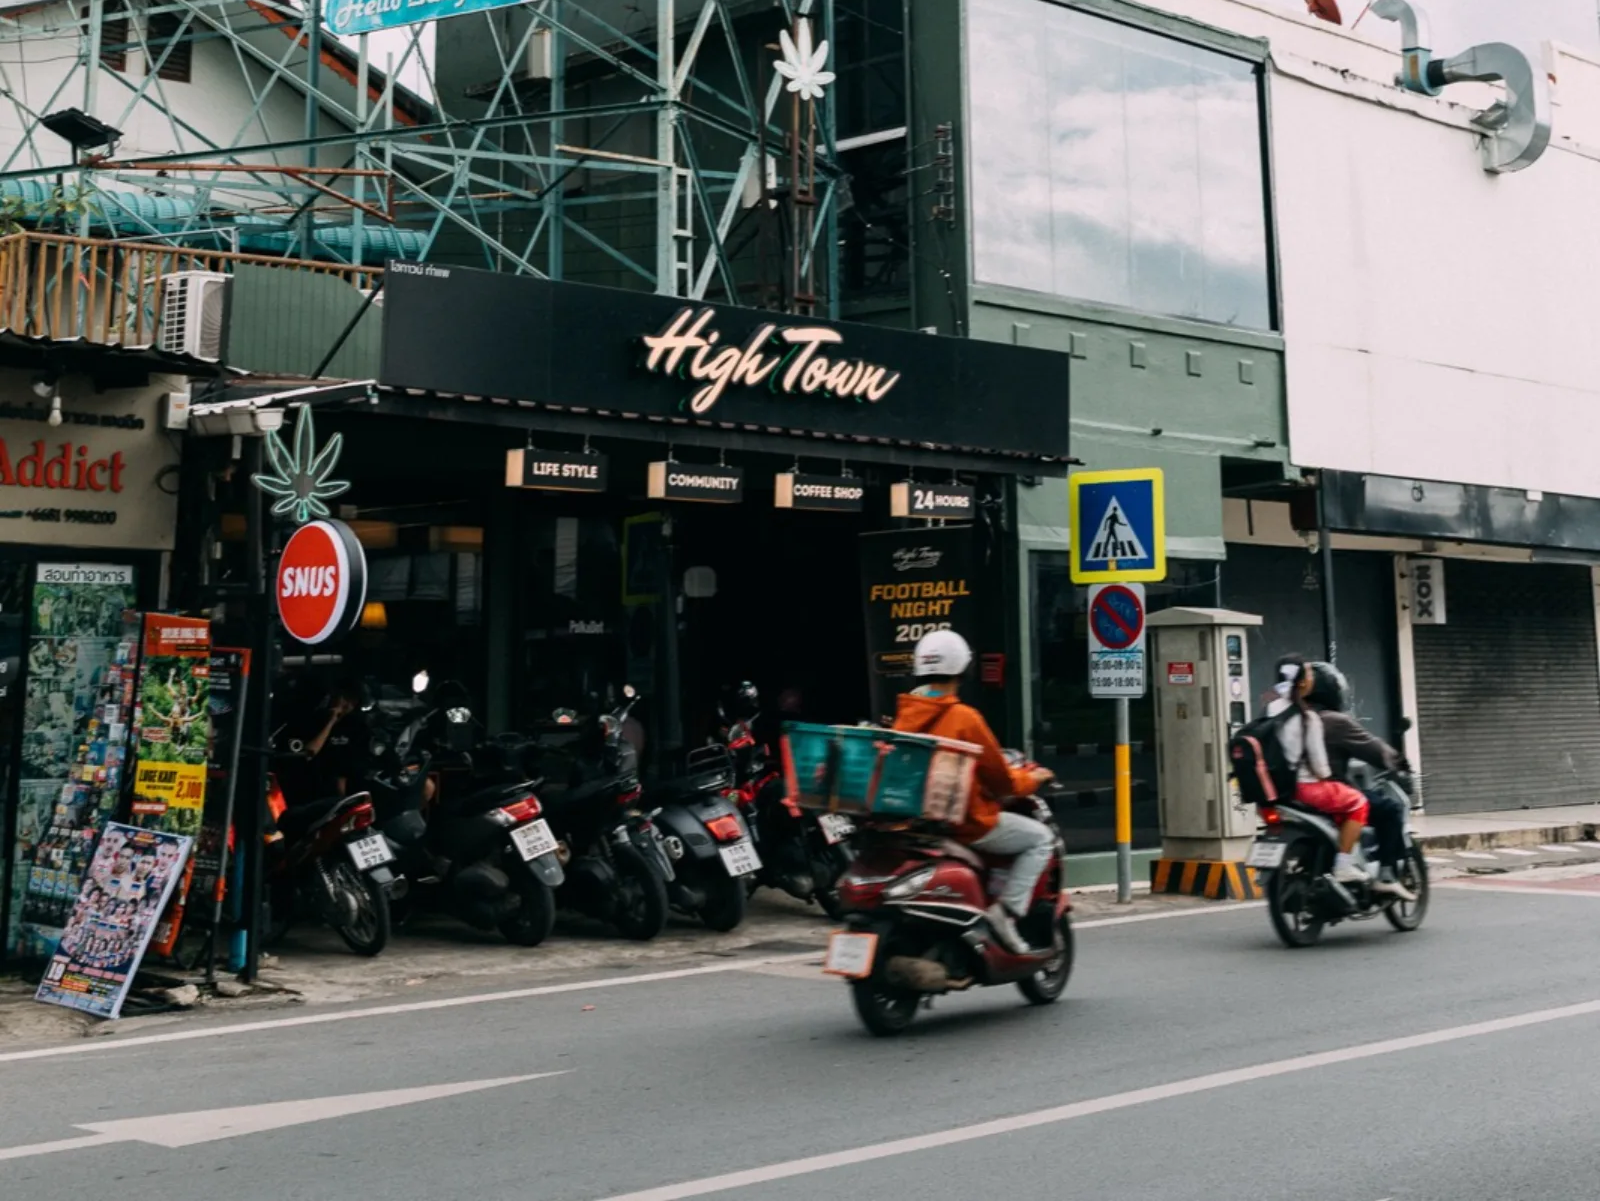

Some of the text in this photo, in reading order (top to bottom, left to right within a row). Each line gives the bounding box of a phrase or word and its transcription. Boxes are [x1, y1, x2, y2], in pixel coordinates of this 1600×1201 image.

[643, 307, 901, 413] High Town
[533, 462, 598, 479] LIFE STYLE
[668, 473, 739, 490] COMMUNITY
[794, 484, 864, 500] COFFEE SHOP
[913, 489, 970, 510] 24 HOURS
[281, 565, 337, 598] SNUS
[870, 579, 971, 601] FOOTBALL
[890, 599, 955, 619] NIGHT
